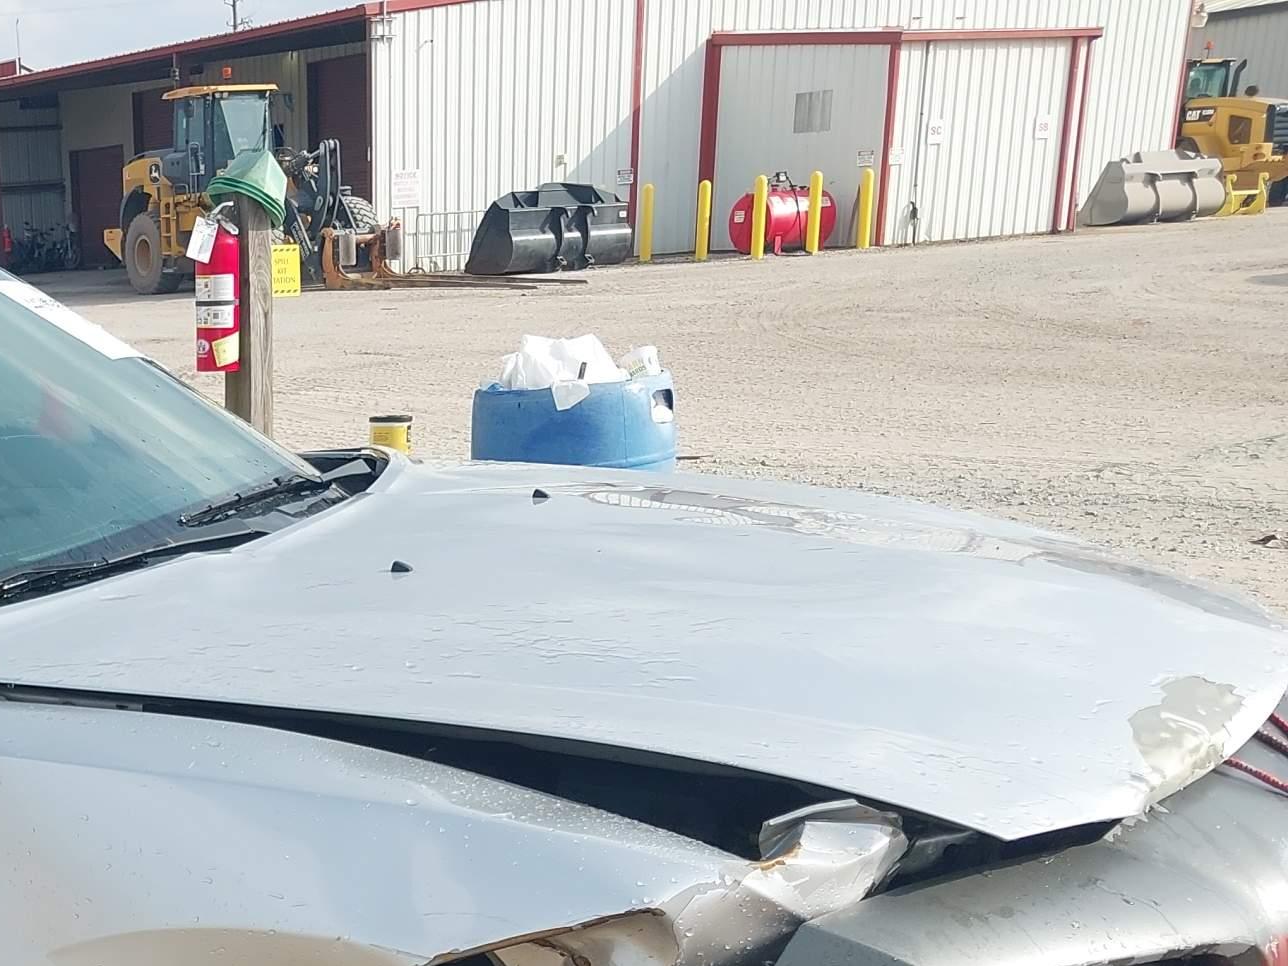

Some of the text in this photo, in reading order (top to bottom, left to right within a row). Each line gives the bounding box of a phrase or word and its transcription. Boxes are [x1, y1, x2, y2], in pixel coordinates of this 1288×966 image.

[1186, 109, 1201, 121] CAT
[930, 126, 942, 136] SC
[277, 267, 287, 275] KIT
[273, 276, 296, 284] TATION
